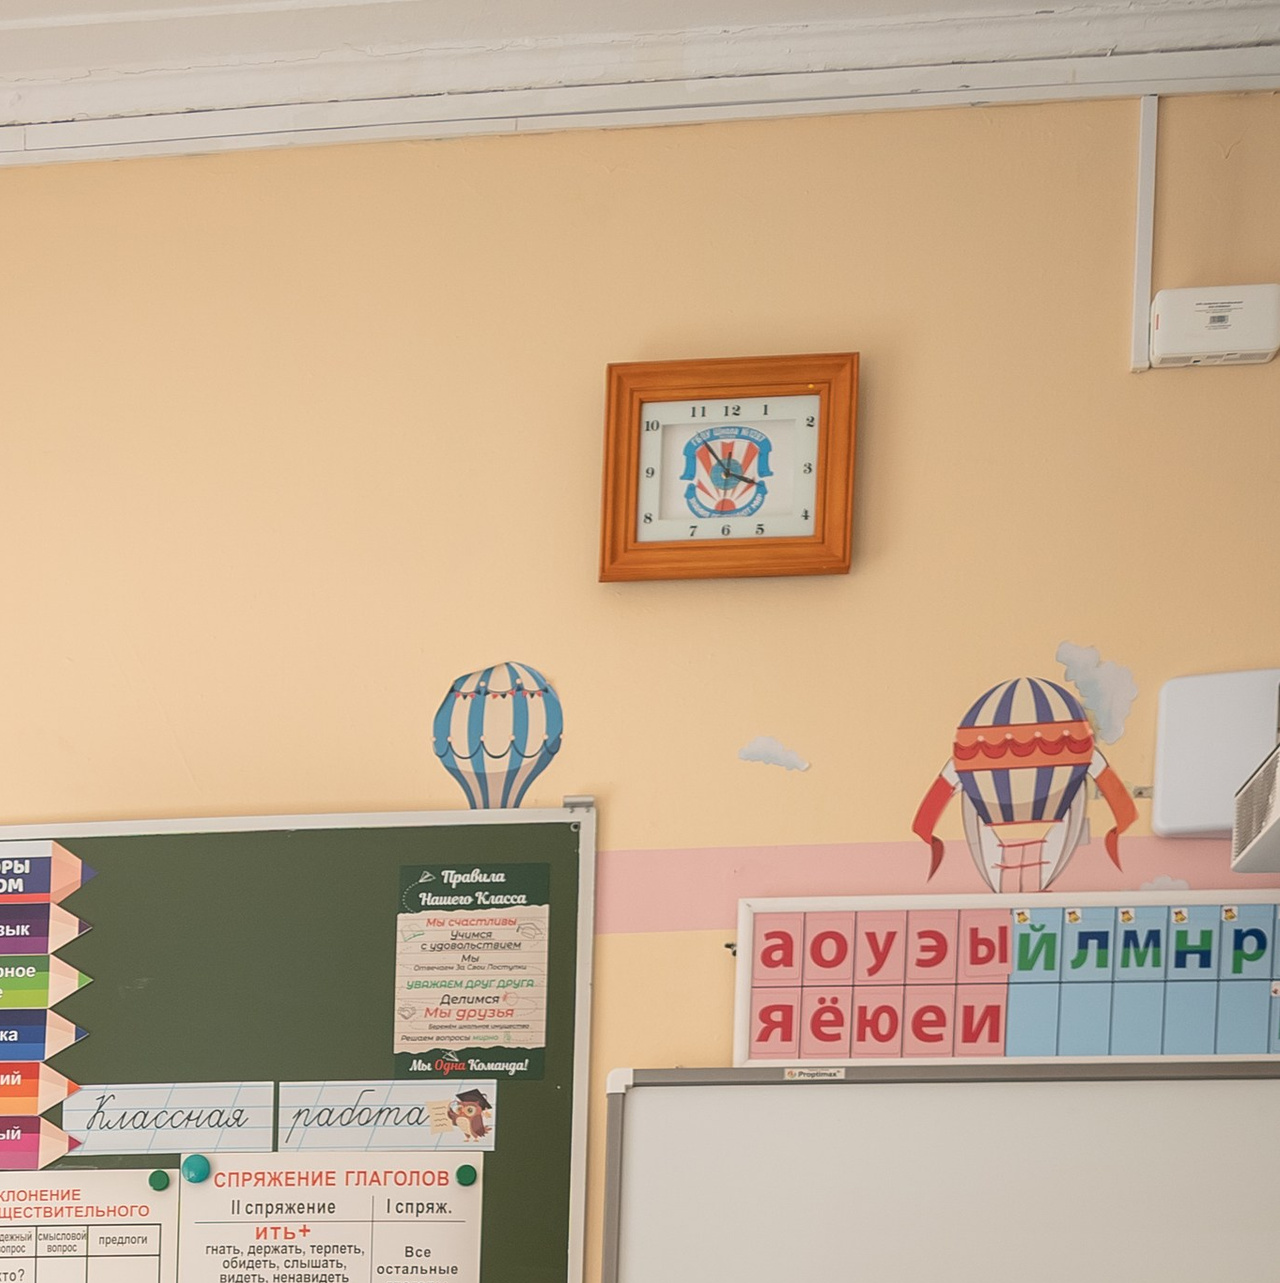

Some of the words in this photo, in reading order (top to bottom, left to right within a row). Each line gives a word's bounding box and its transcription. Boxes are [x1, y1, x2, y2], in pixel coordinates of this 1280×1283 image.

[691, 407, 707, 417] 11
[723, 405, 741, 416] 12
[763, 405, 768, 415] 1
[645, 420, 660, 431] 10
[806, 416, 815, 427] 2
[646, 467, 655, 478] 9
[803, 463, 812, 474] 3
[644, 513, 653, 524] 8
[801, 510, 810, 520] 4
[689, 525, 698, 536] 7
[721, 525, 730, 535] 6
[755, 524, 765, 535] 5
[441, 868, 506, 888] Правила
[419, 892, 473, 906] Нашего
[475, 892, 527, 905] Класса
[426, 918, 445, 927] Мы
[449, 918, 517, 927] счастливы
[451, 931, 492, 940] Учимся
[430, 941, 521, 951] удовольствием
[407, 980, 463, 990] УВАЖАЕМ
[465, 980, 495, 989] ДРУГ
[497, 979, 534, 989] ДРУГА
[440, 994, 499, 1006] Делимся
[424, 1008, 452, 1018] Мы
[456, 1009, 514, 1021] друзья
[409, 1059, 432, 1072] Мы
[435, 1059, 466, 1075] Одна
[468, 1059, 528, 1075] Команда!
[87, 1093, 249, 1130] Классная
[285, 1089, 430, 1143] работа
[214, 1171, 336, 1188] СПРЯЖЕНИЕ
[345, 1170, 449, 1186] ГЛАГОЛОВ
[245, 1201, 336, 1218] спряжение
[396, 1200, 452, 1217] спряж.
[38, 1229, 87, 1243] смысловой
[98, 1234, 147, 1247] предлоги
[47, 1243, 77, 1255] вопрос
[206, 1245, 244, 1256] гнать,
[247, 1244, 306, 1258] держать,
[310, 1244, 365, 1256] терпеть,
[405, 1246, 431, 1258] Все
[222, 1257, 279, 1271] обидеть,
[284, 1258, 347, 1270] слышать,
[377, 1264, 458, 1275] остальные
